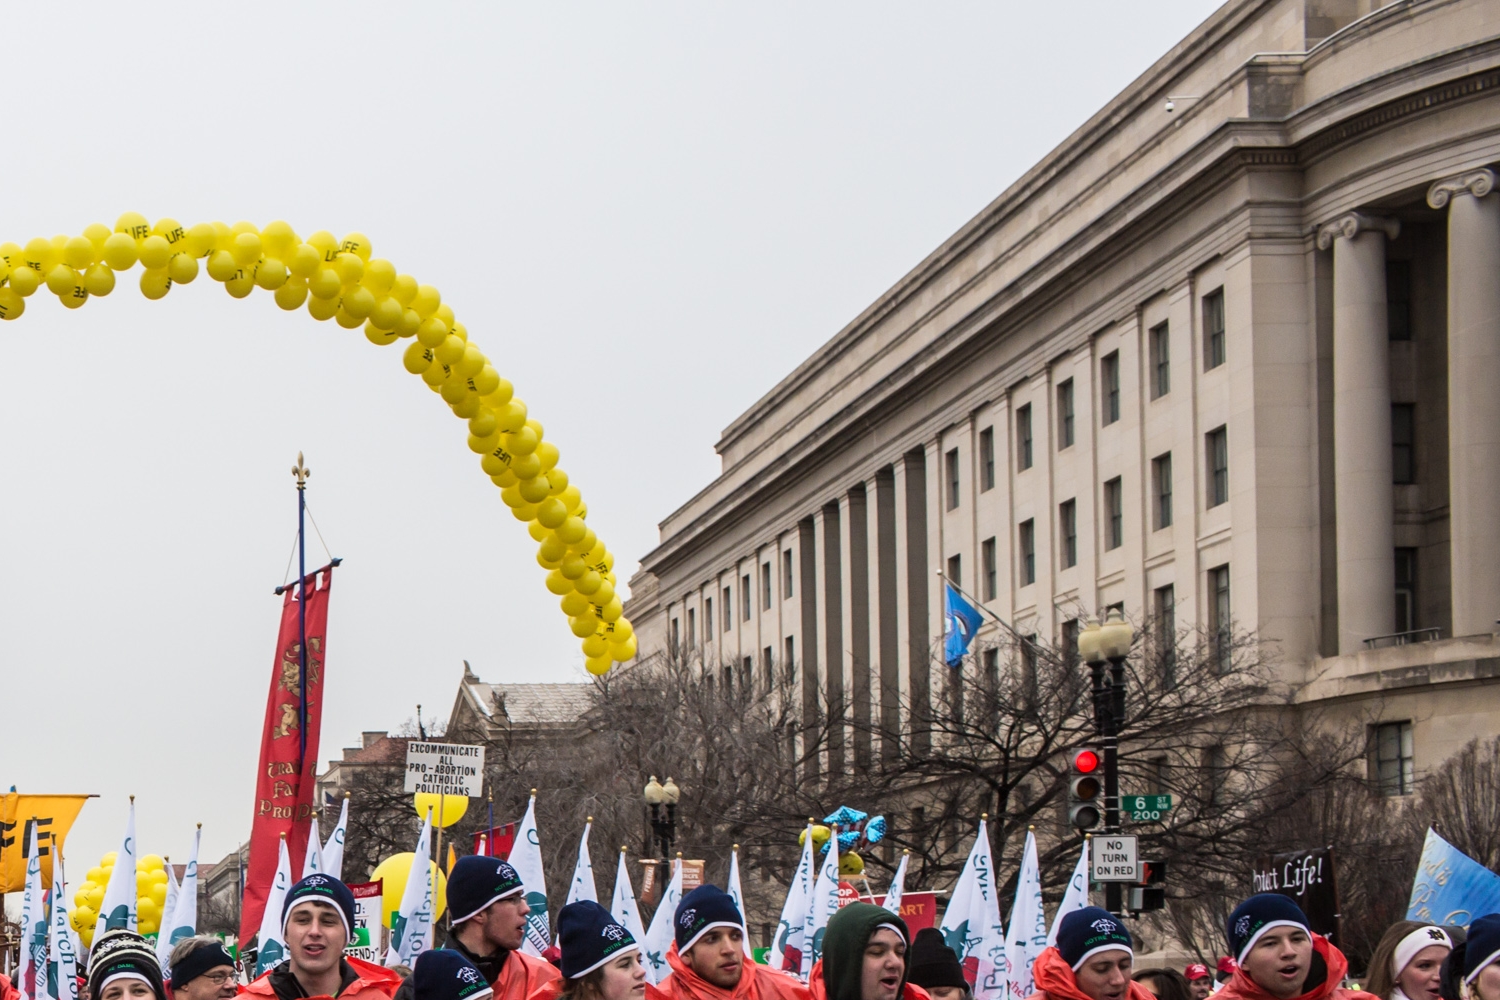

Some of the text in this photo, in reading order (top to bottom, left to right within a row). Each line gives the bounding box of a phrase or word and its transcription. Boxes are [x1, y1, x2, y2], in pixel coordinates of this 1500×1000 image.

[165, 226, 186, 244] LIFE
[439, 755, 454, 766] ALL
[422, 773, 464, 786] CATHOLIC
[415, 783, 470, 797] POLITICIANS
[1135, 797, 1146, 810] 6
[1133, 811, 1160, 820] 200
[1106, 841, 1122, 850] NO
[1102, 853, 1128, 863] TURN
[1097, 866, 1133, 876] ON RED
[1282, 855, 1323, 896] Life!
[838, 888, 853, 897] OP
[899, 903, 925, 917] ART
